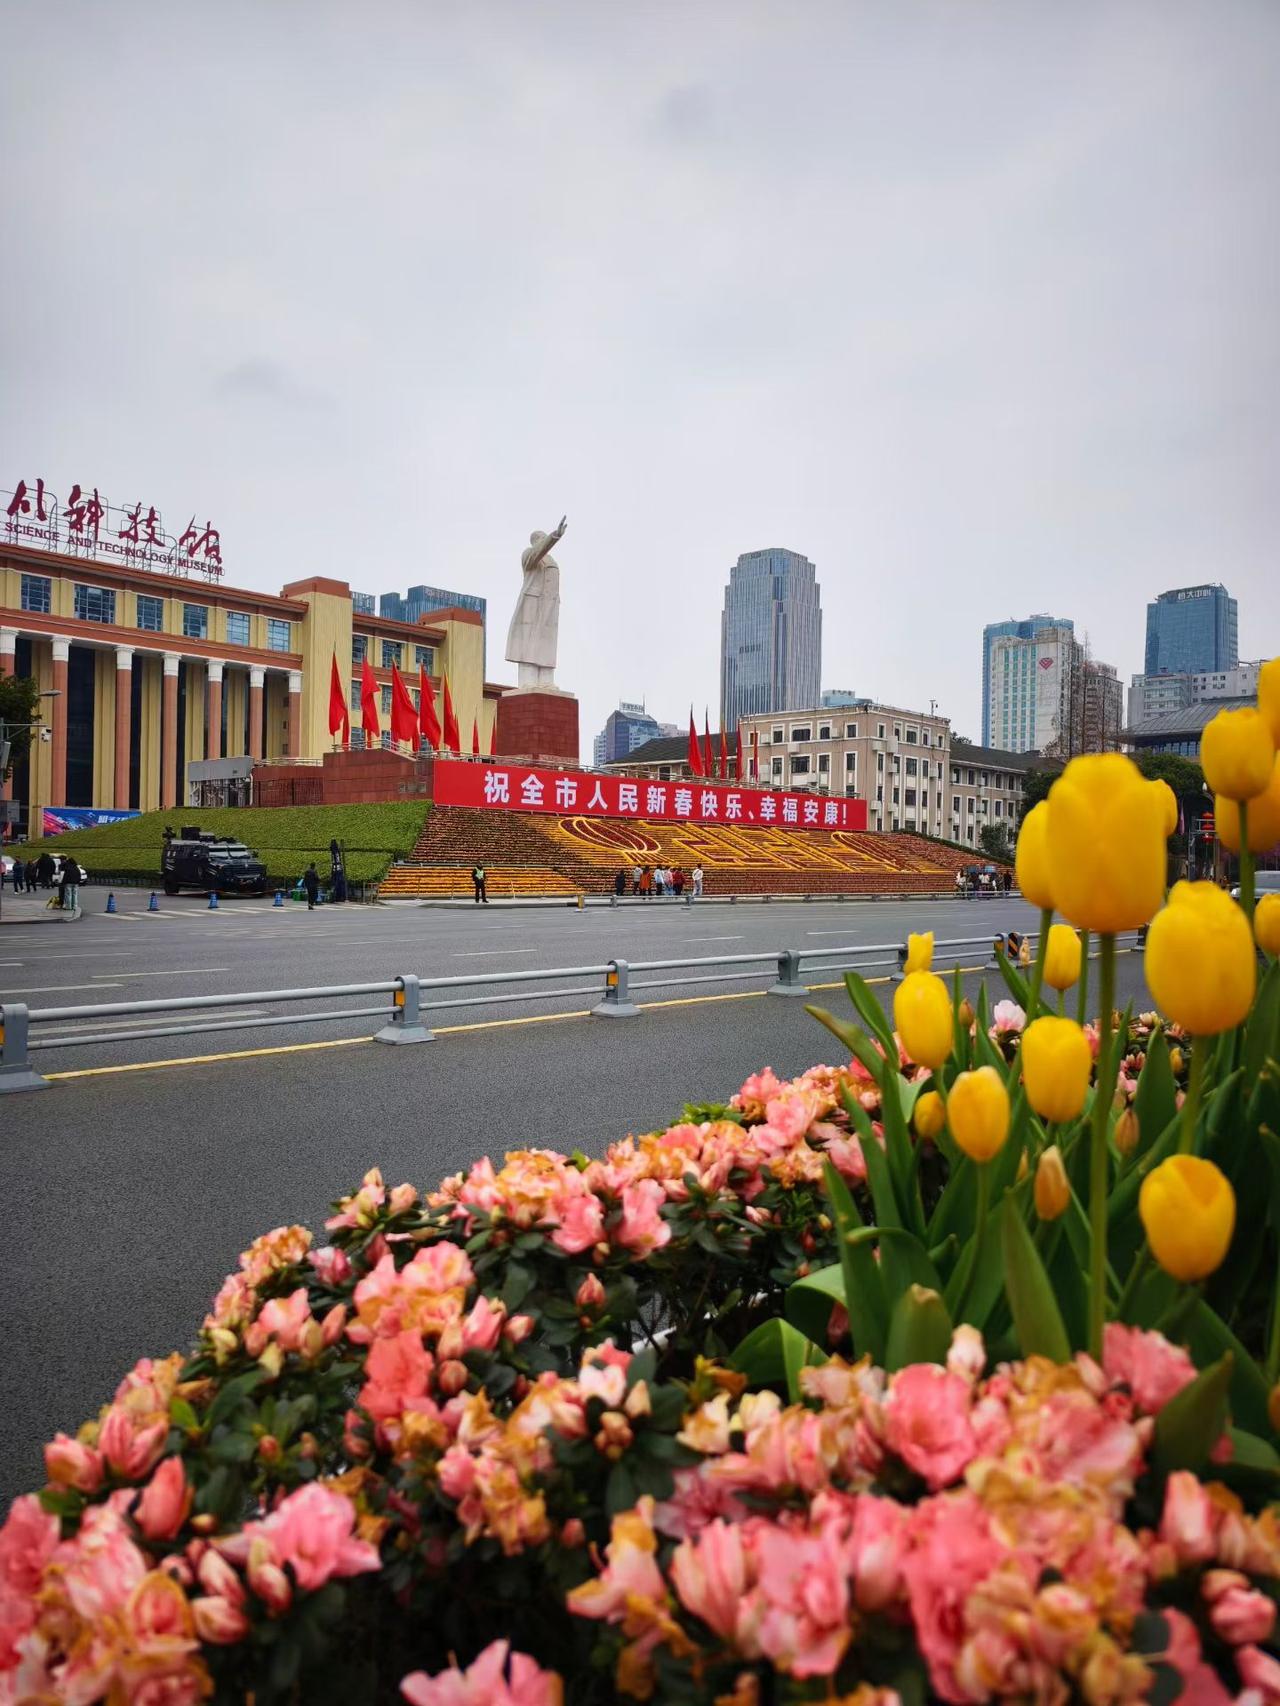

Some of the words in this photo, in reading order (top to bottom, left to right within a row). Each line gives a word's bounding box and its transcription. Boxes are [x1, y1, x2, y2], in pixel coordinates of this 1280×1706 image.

[5, 522, 60, 541] SCIENCE
[67, 535, 92, 548] AND
[100, 541, 174, 565] TECHNOLOGY
[178, 558, 223, 576] MUSEUM
